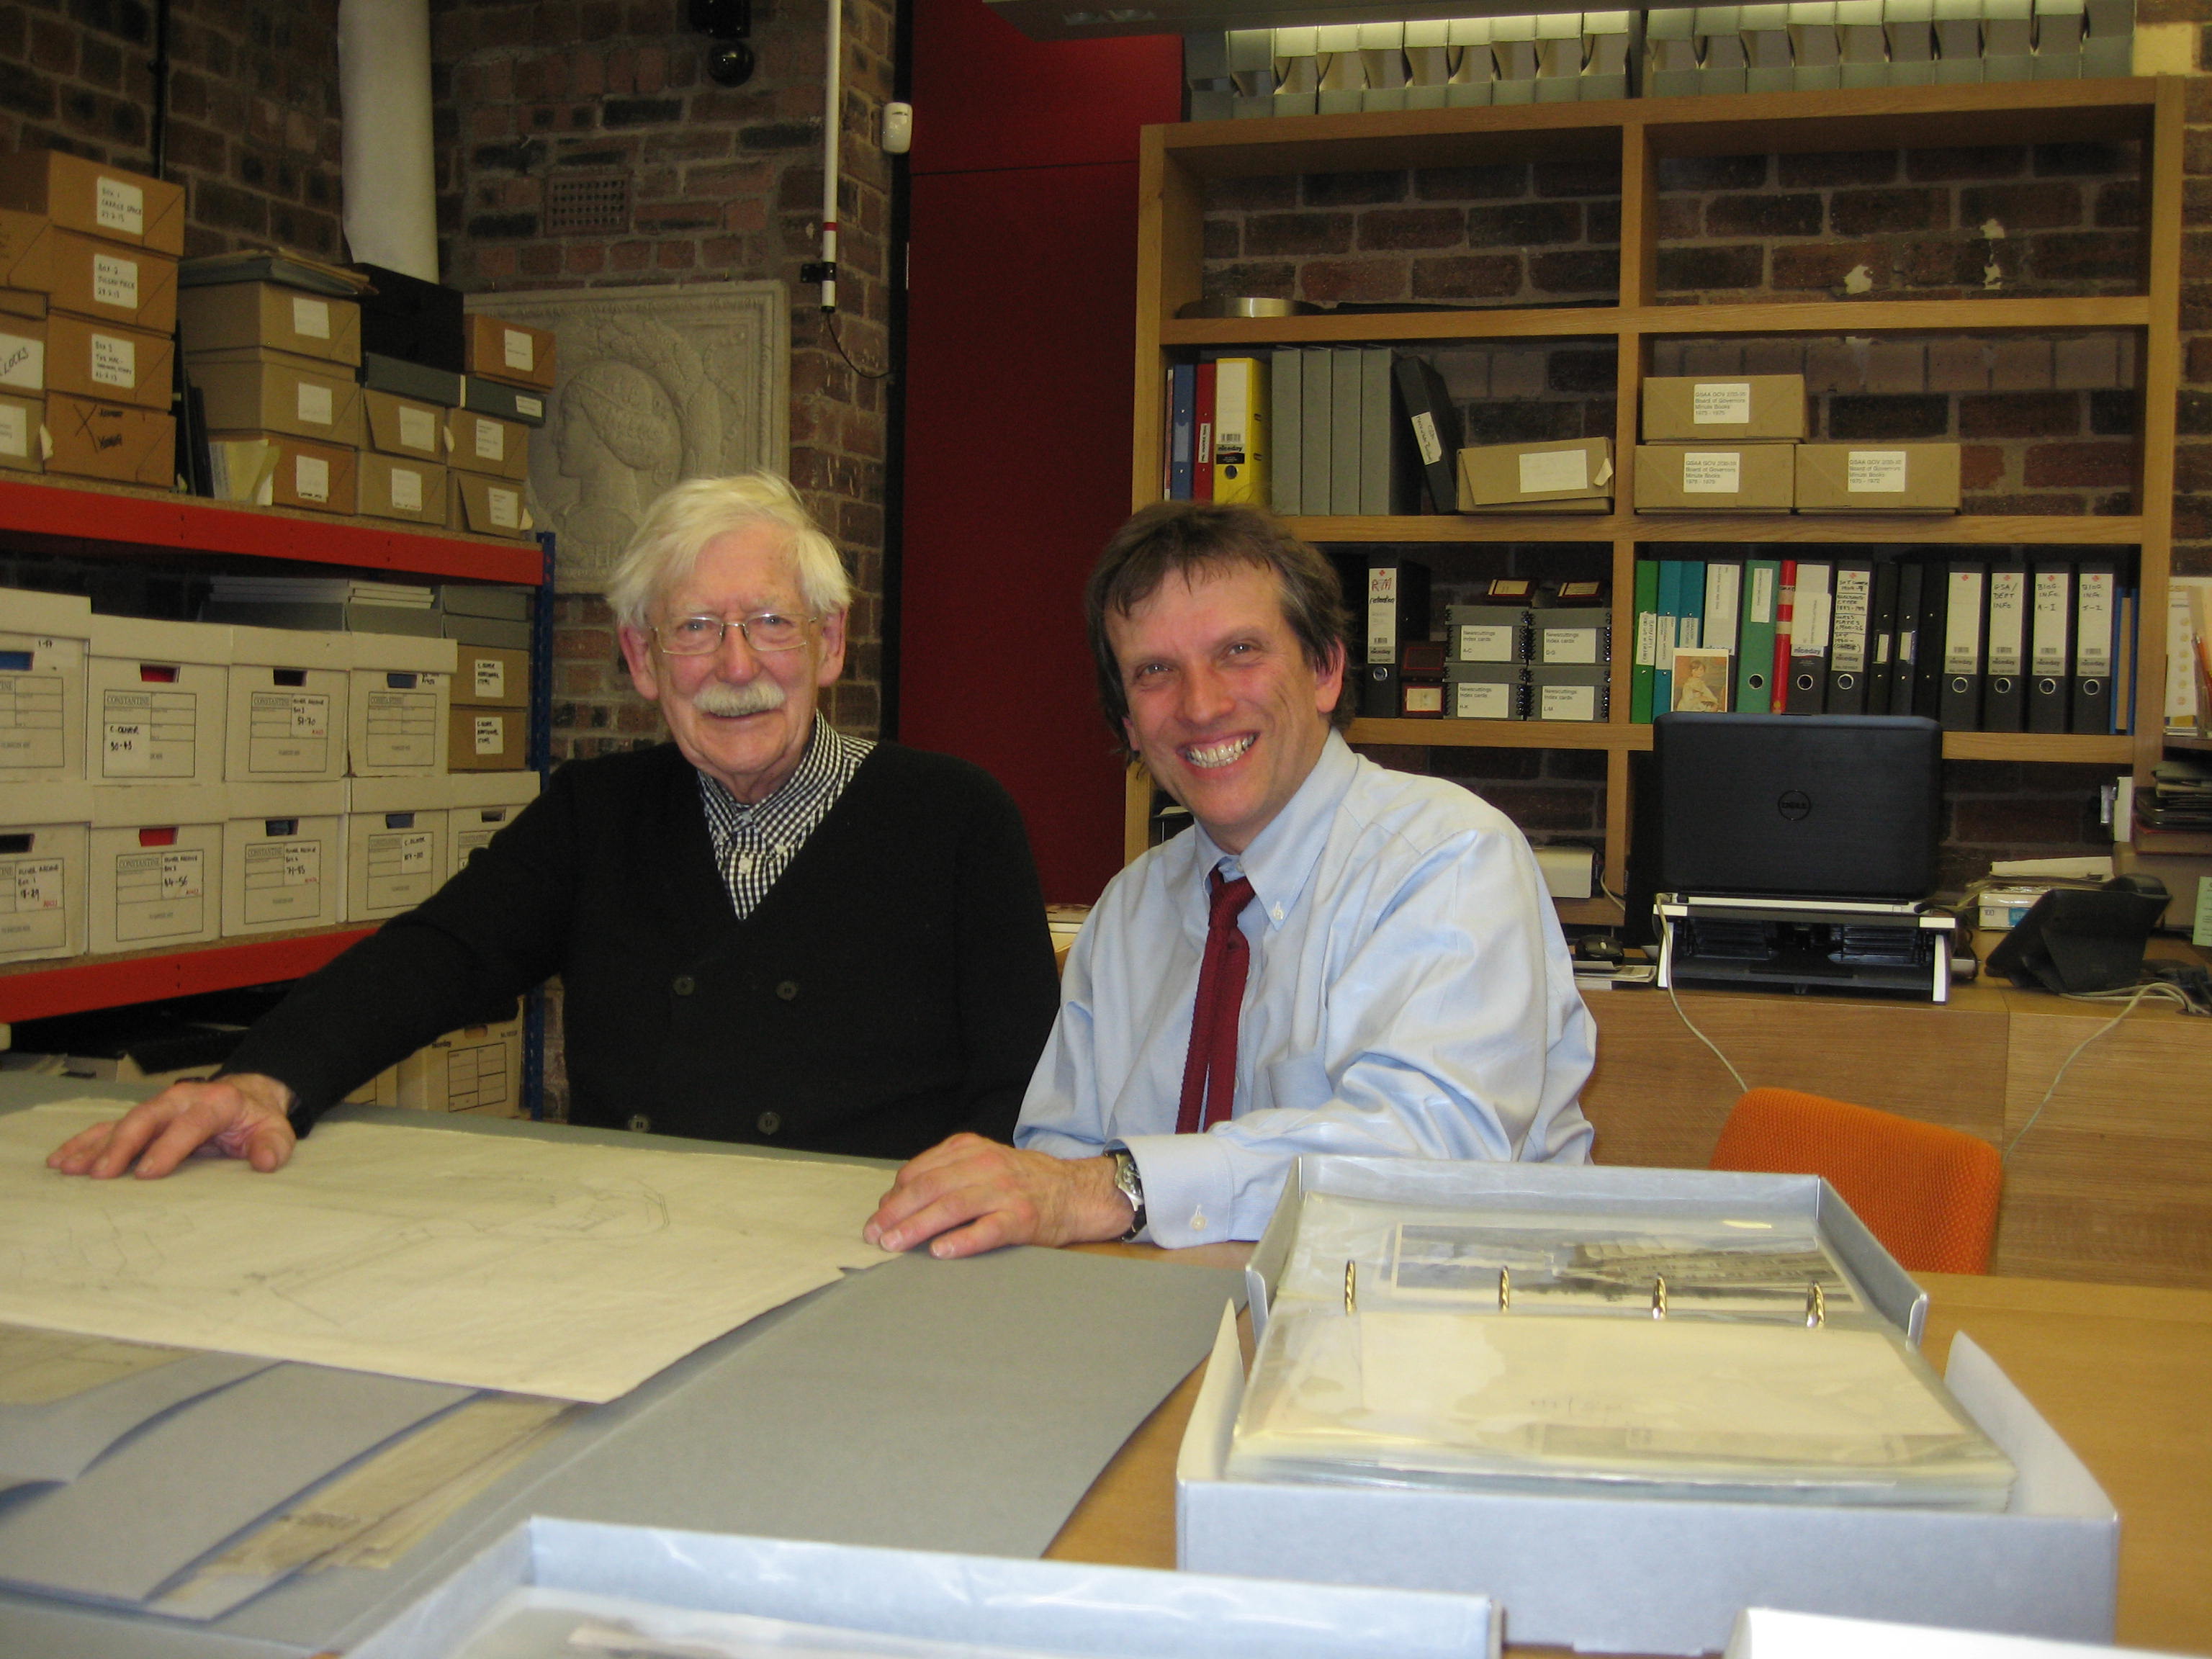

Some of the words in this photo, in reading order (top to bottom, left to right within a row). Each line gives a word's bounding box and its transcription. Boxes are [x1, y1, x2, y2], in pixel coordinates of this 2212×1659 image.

[107, 696, 150, 706] CONSTANTINE
[253, 696, 289, 706] CONSTANTINE
[117, 727, 139, 735] OLIVER
[247, 847, 283, 858] CONSTANTINE
[119, 858, 161, 869] CONSTANTINE
